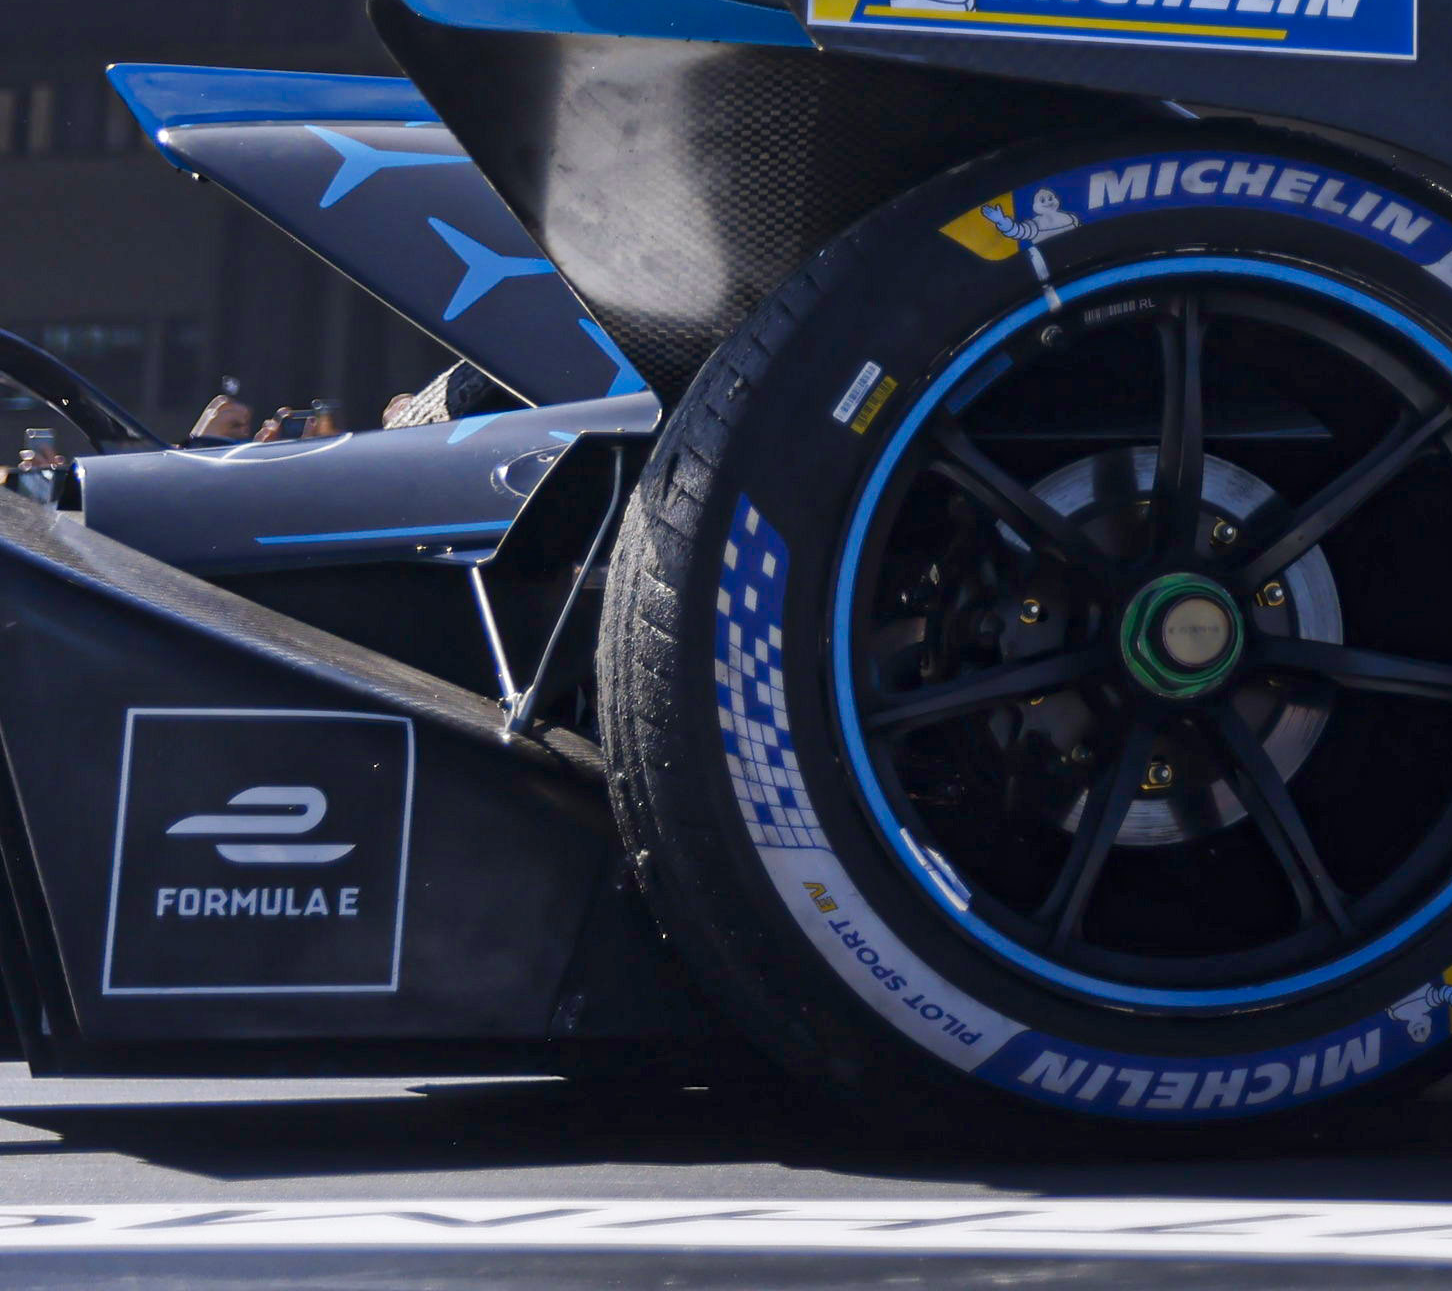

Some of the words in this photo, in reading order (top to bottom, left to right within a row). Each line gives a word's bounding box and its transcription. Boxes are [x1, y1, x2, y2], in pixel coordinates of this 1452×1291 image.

[1086, 157, 1434, 247] MICHELIN
[155, 887, 330, 918] FORMULA
[338, 886, 361, 917] E
[803, 881, 839, 914] EV
[828, 919, 908, 992] SPORT
[901, 993, 984, 1047] PILOT
[1018, 1026, 1384, 1111] MICHELIN
